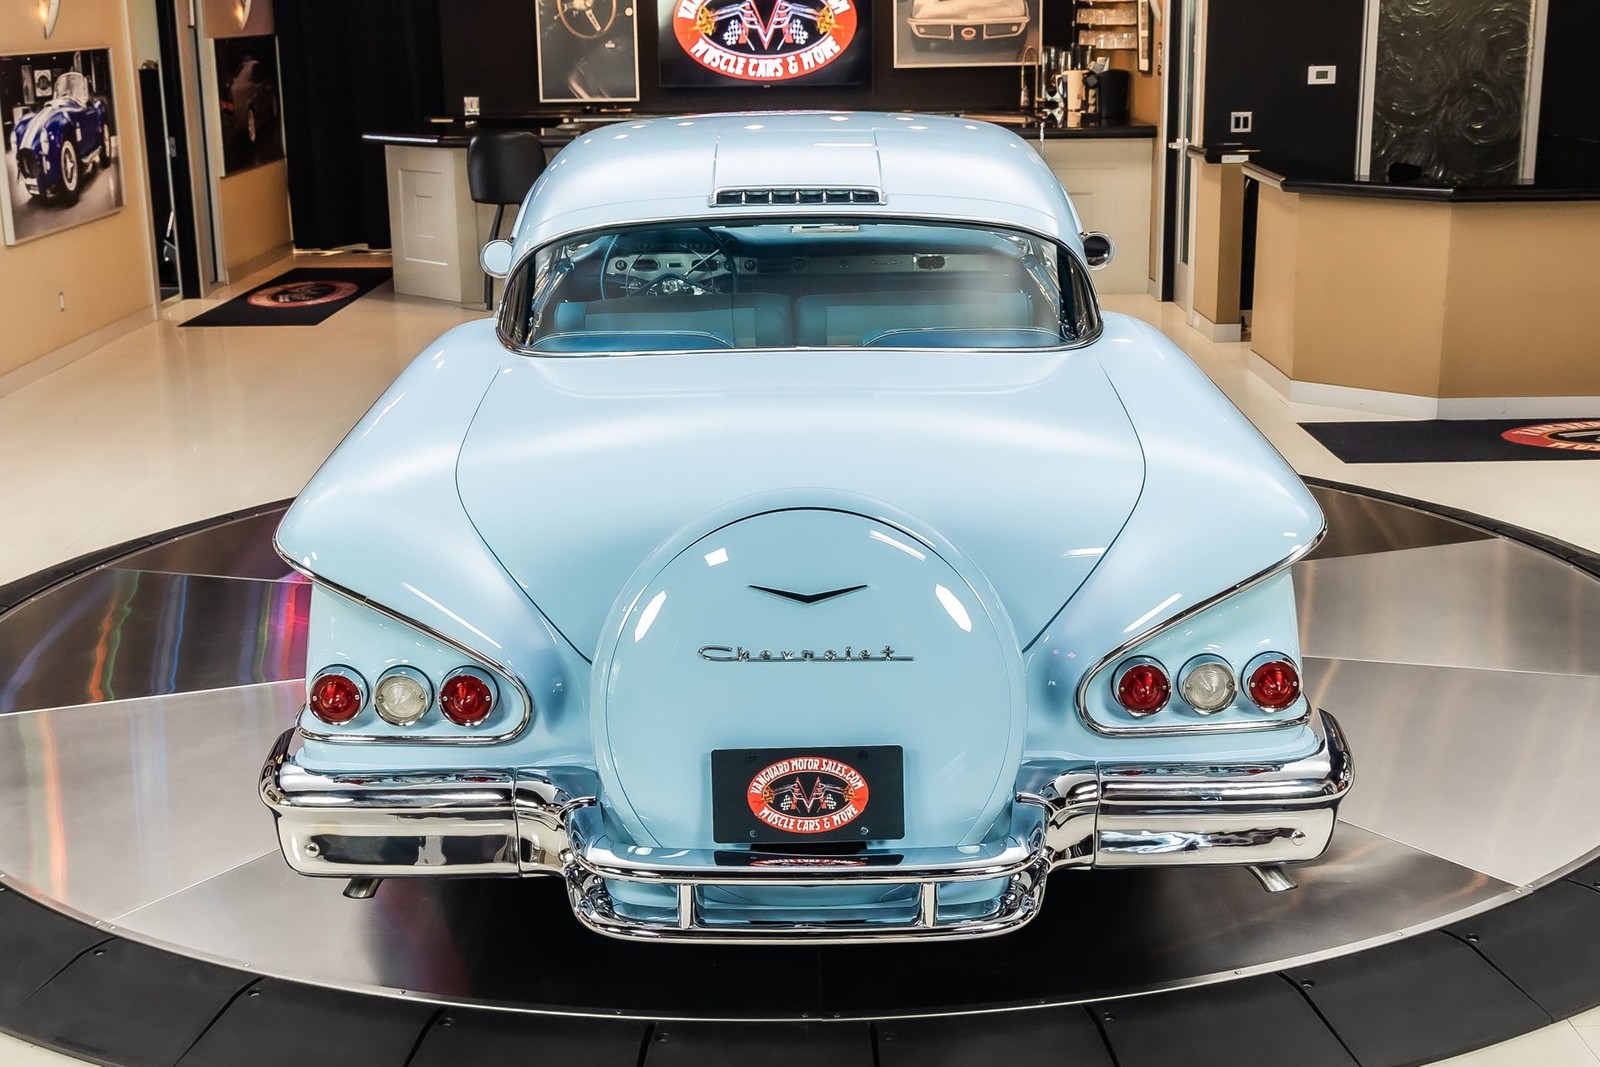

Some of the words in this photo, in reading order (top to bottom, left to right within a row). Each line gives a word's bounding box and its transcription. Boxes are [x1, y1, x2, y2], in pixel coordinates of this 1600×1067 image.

[690, 38, 746, 75] MUSCLE
[748, 58, 783, 78] CARS
[788, 55, 799, 75] &
[801, 36, 841, 71] MORE
[698, 645, 914, 662] Chevrolet
[750, 761, 790, 794] VANGUARD
[790, 758, 820, 771] MOTOR
[820, 759, 865, 790] SALES.COM
[758, 806, 794, 830] MUSCLE
[796, 819, 821, 831] CARS
[822, 818, 831, 829] &
[832, 804, 859, 826] MORE
